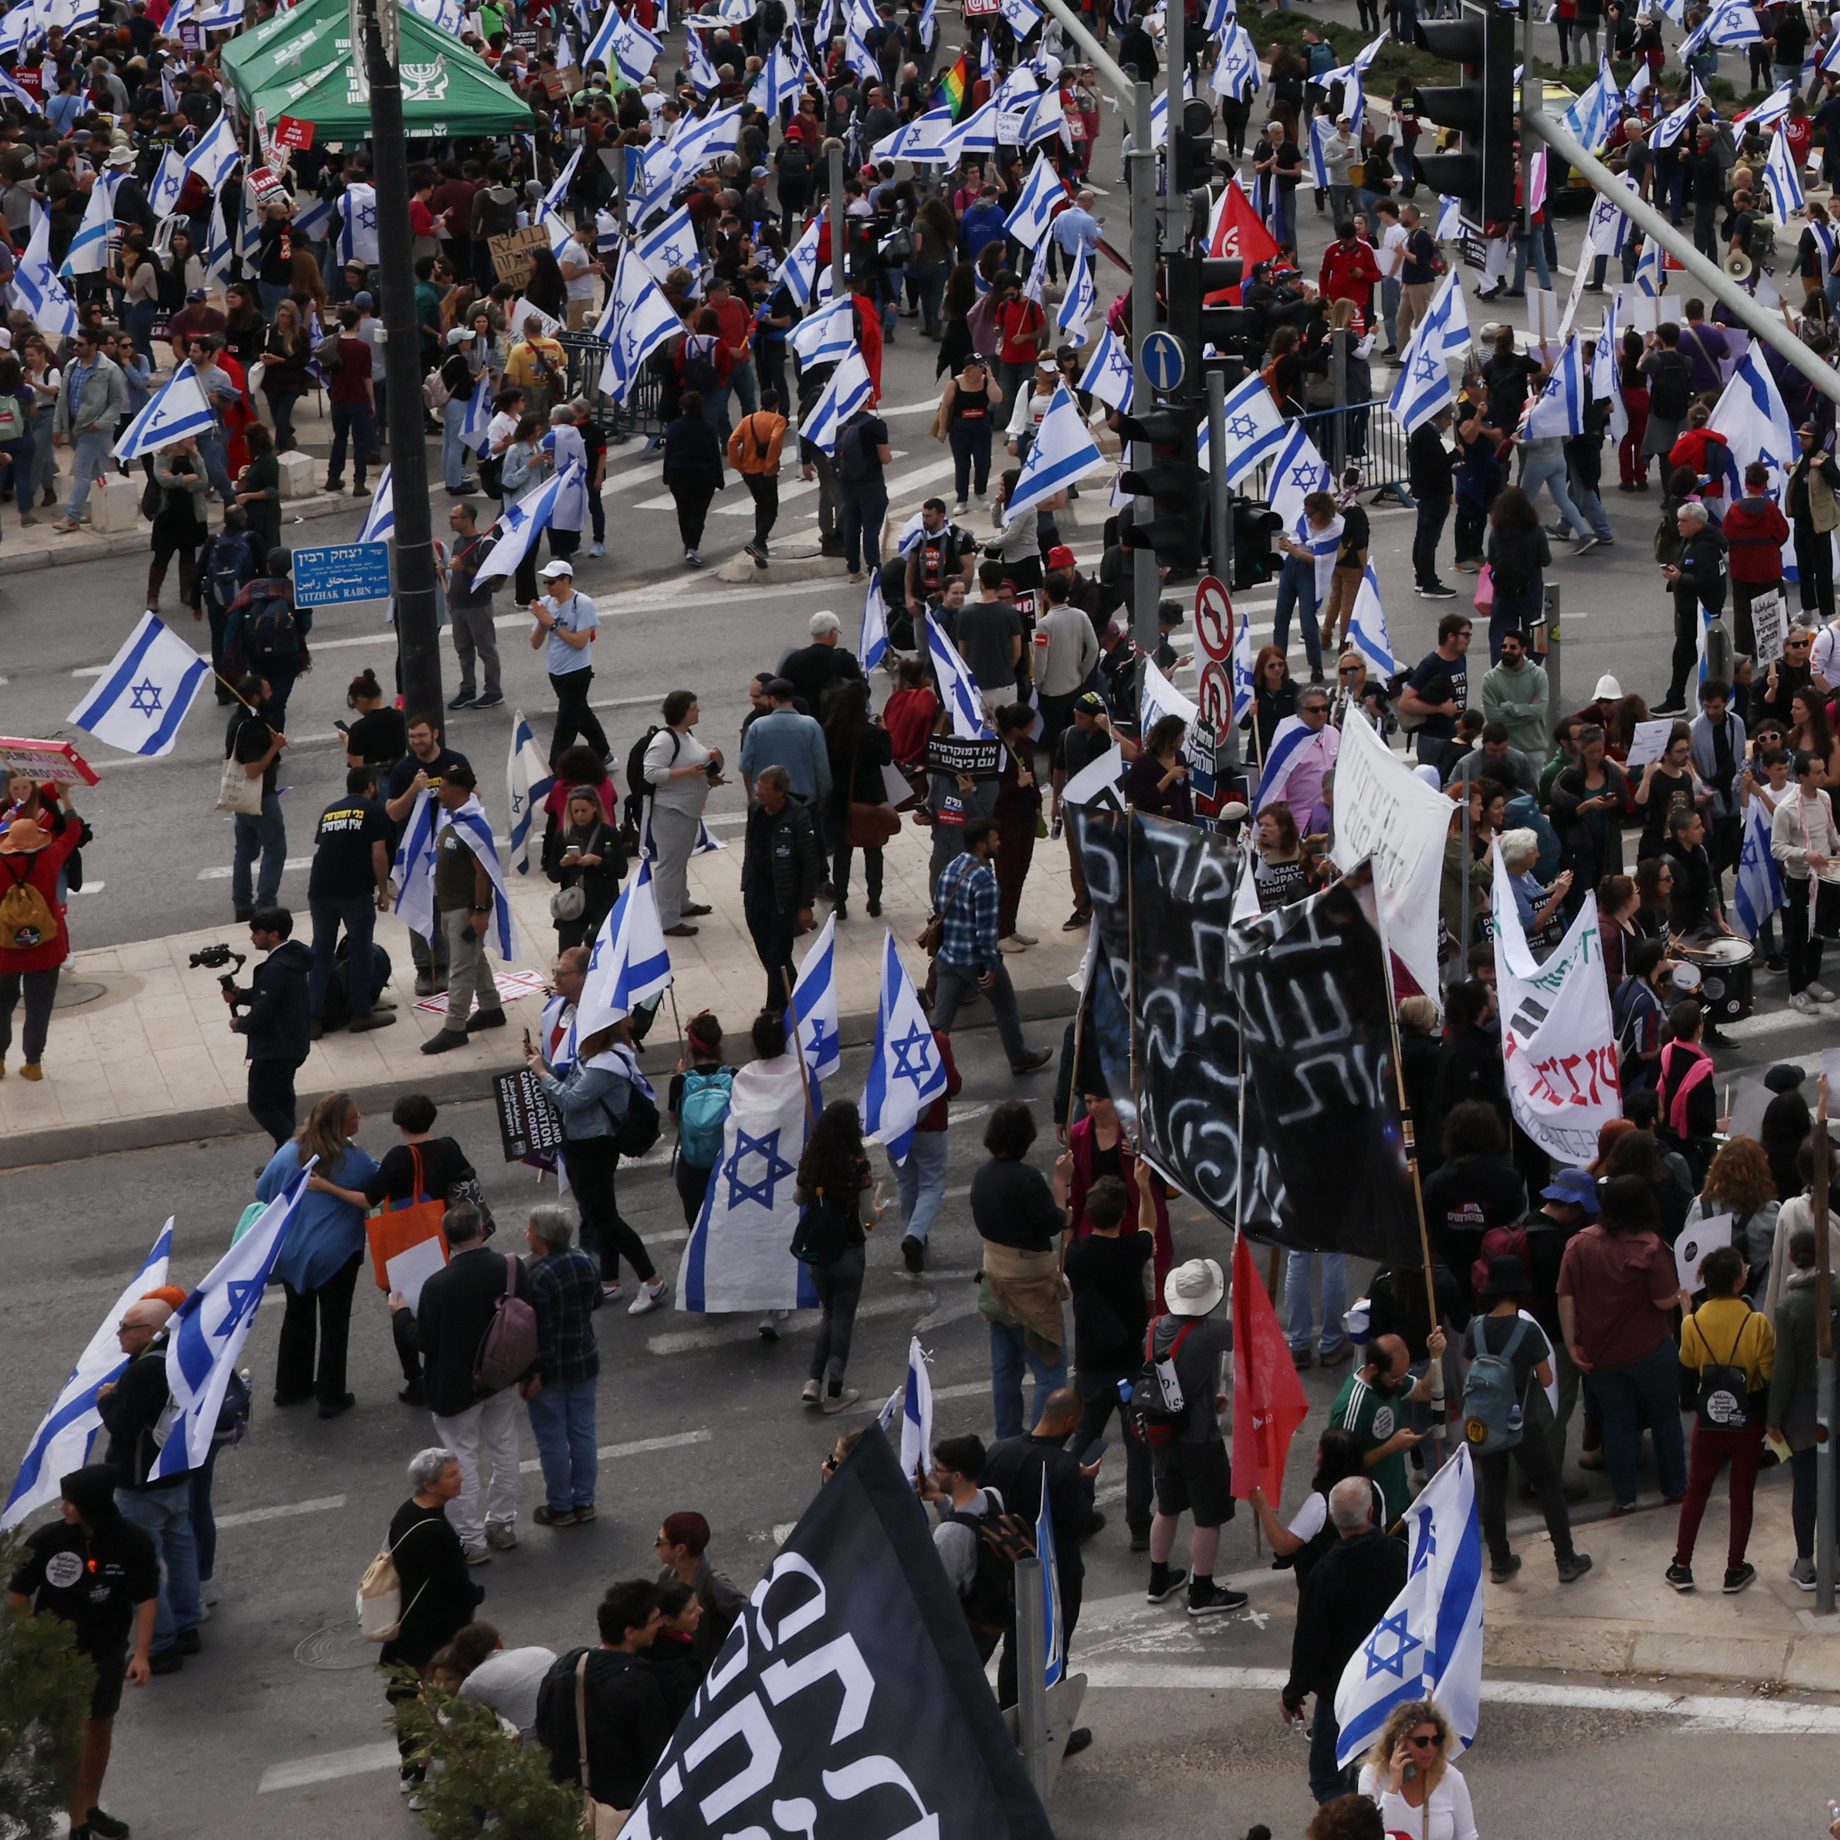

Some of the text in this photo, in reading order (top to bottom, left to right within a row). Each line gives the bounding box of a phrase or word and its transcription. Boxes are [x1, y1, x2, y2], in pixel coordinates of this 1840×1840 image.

[297, 552, 325, 568] רבין
[331, 547, 363, 563] יצחק
[299, 587, 371, 604] YITZHAK RABIN
[929, 741, 997, 758] אין דמוקרטיה
[941, 754, 996, 769] עם כיבוש
[323, 809, 365, 822] בלי דמוקרטיה
[321, 818, 363, 834] אין אקדמיה
[1271, 863, 1300, 876] OCRACY
[1259, 871, 1305, 888] CCUPAT
[519, 1071, 541, 1151] CANNOT COEXIST
[528, 1069, 553, 1148] OCCUPATION
[550, 1122, 563, 1145] AND
